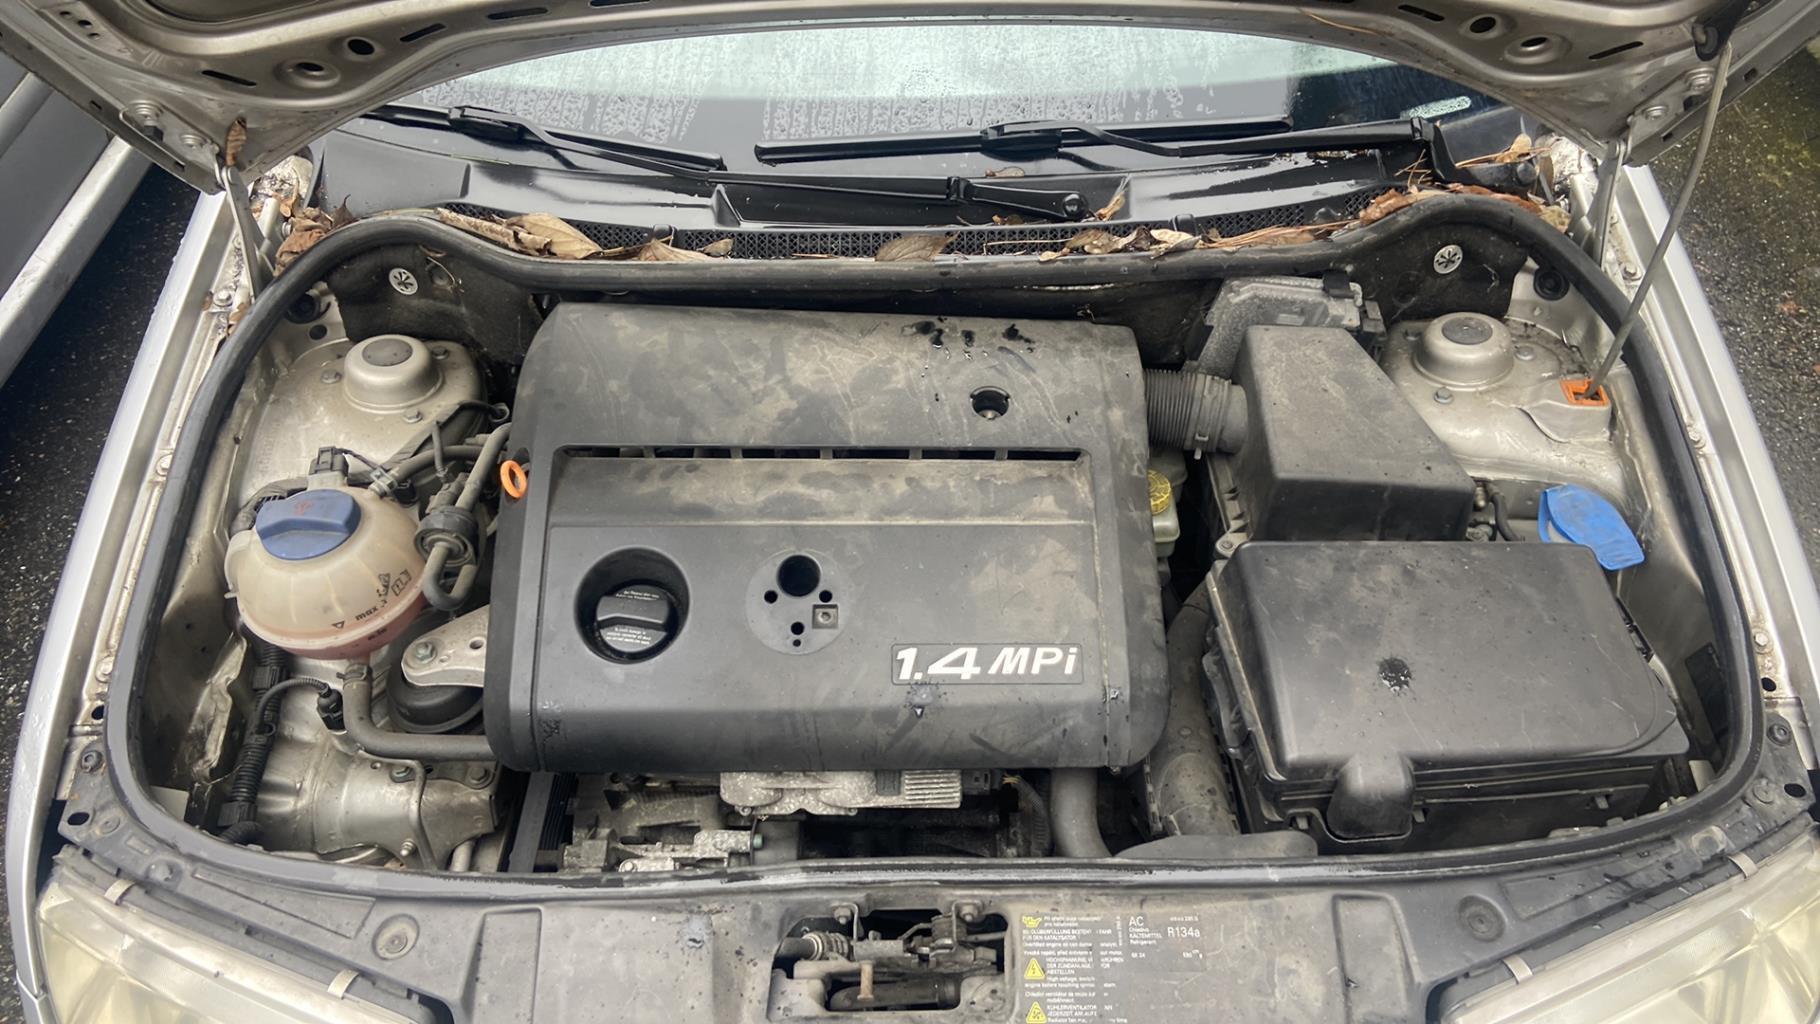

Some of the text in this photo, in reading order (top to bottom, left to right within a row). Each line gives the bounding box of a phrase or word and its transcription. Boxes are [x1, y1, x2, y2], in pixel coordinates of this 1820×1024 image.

[355, 606, 379, 621] max
[896, 647, 1078, 680] 1.4 MPi
[1128, 916, 1144, 927] AC
[1167, 926, 1201, 938] R134a
